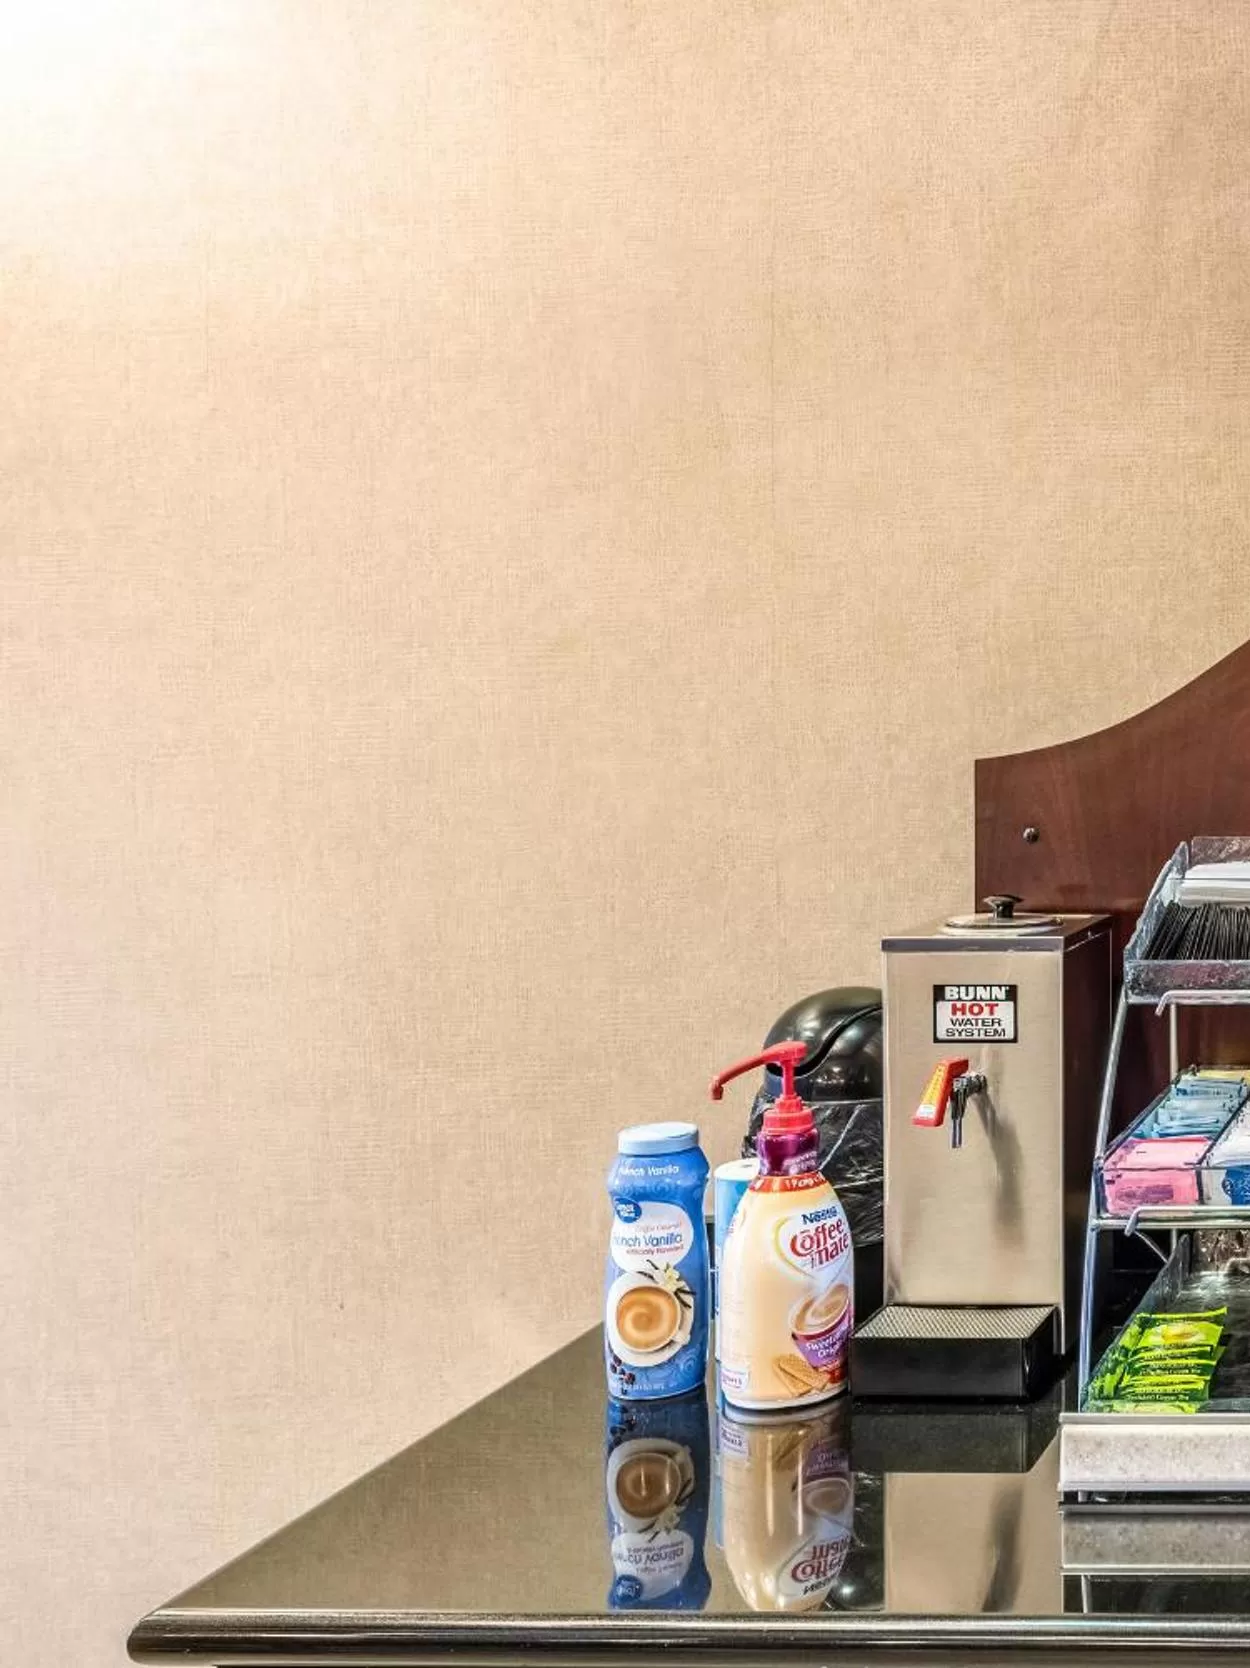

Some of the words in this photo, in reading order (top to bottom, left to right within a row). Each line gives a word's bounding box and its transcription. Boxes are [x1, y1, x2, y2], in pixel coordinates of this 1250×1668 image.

[944, 986, 1006, 1001] BUNN
[951, 1003, 999, 1016] HOT
[949, 1018, 1002, 1027] WATER
[945, 1028, 1006, 1038] SYSTEM
[644, 1232, 684, 1247] Vanilla
[790, 1218, 845, 1257] Coffee
[811, 1232, 849, 1269] mate
